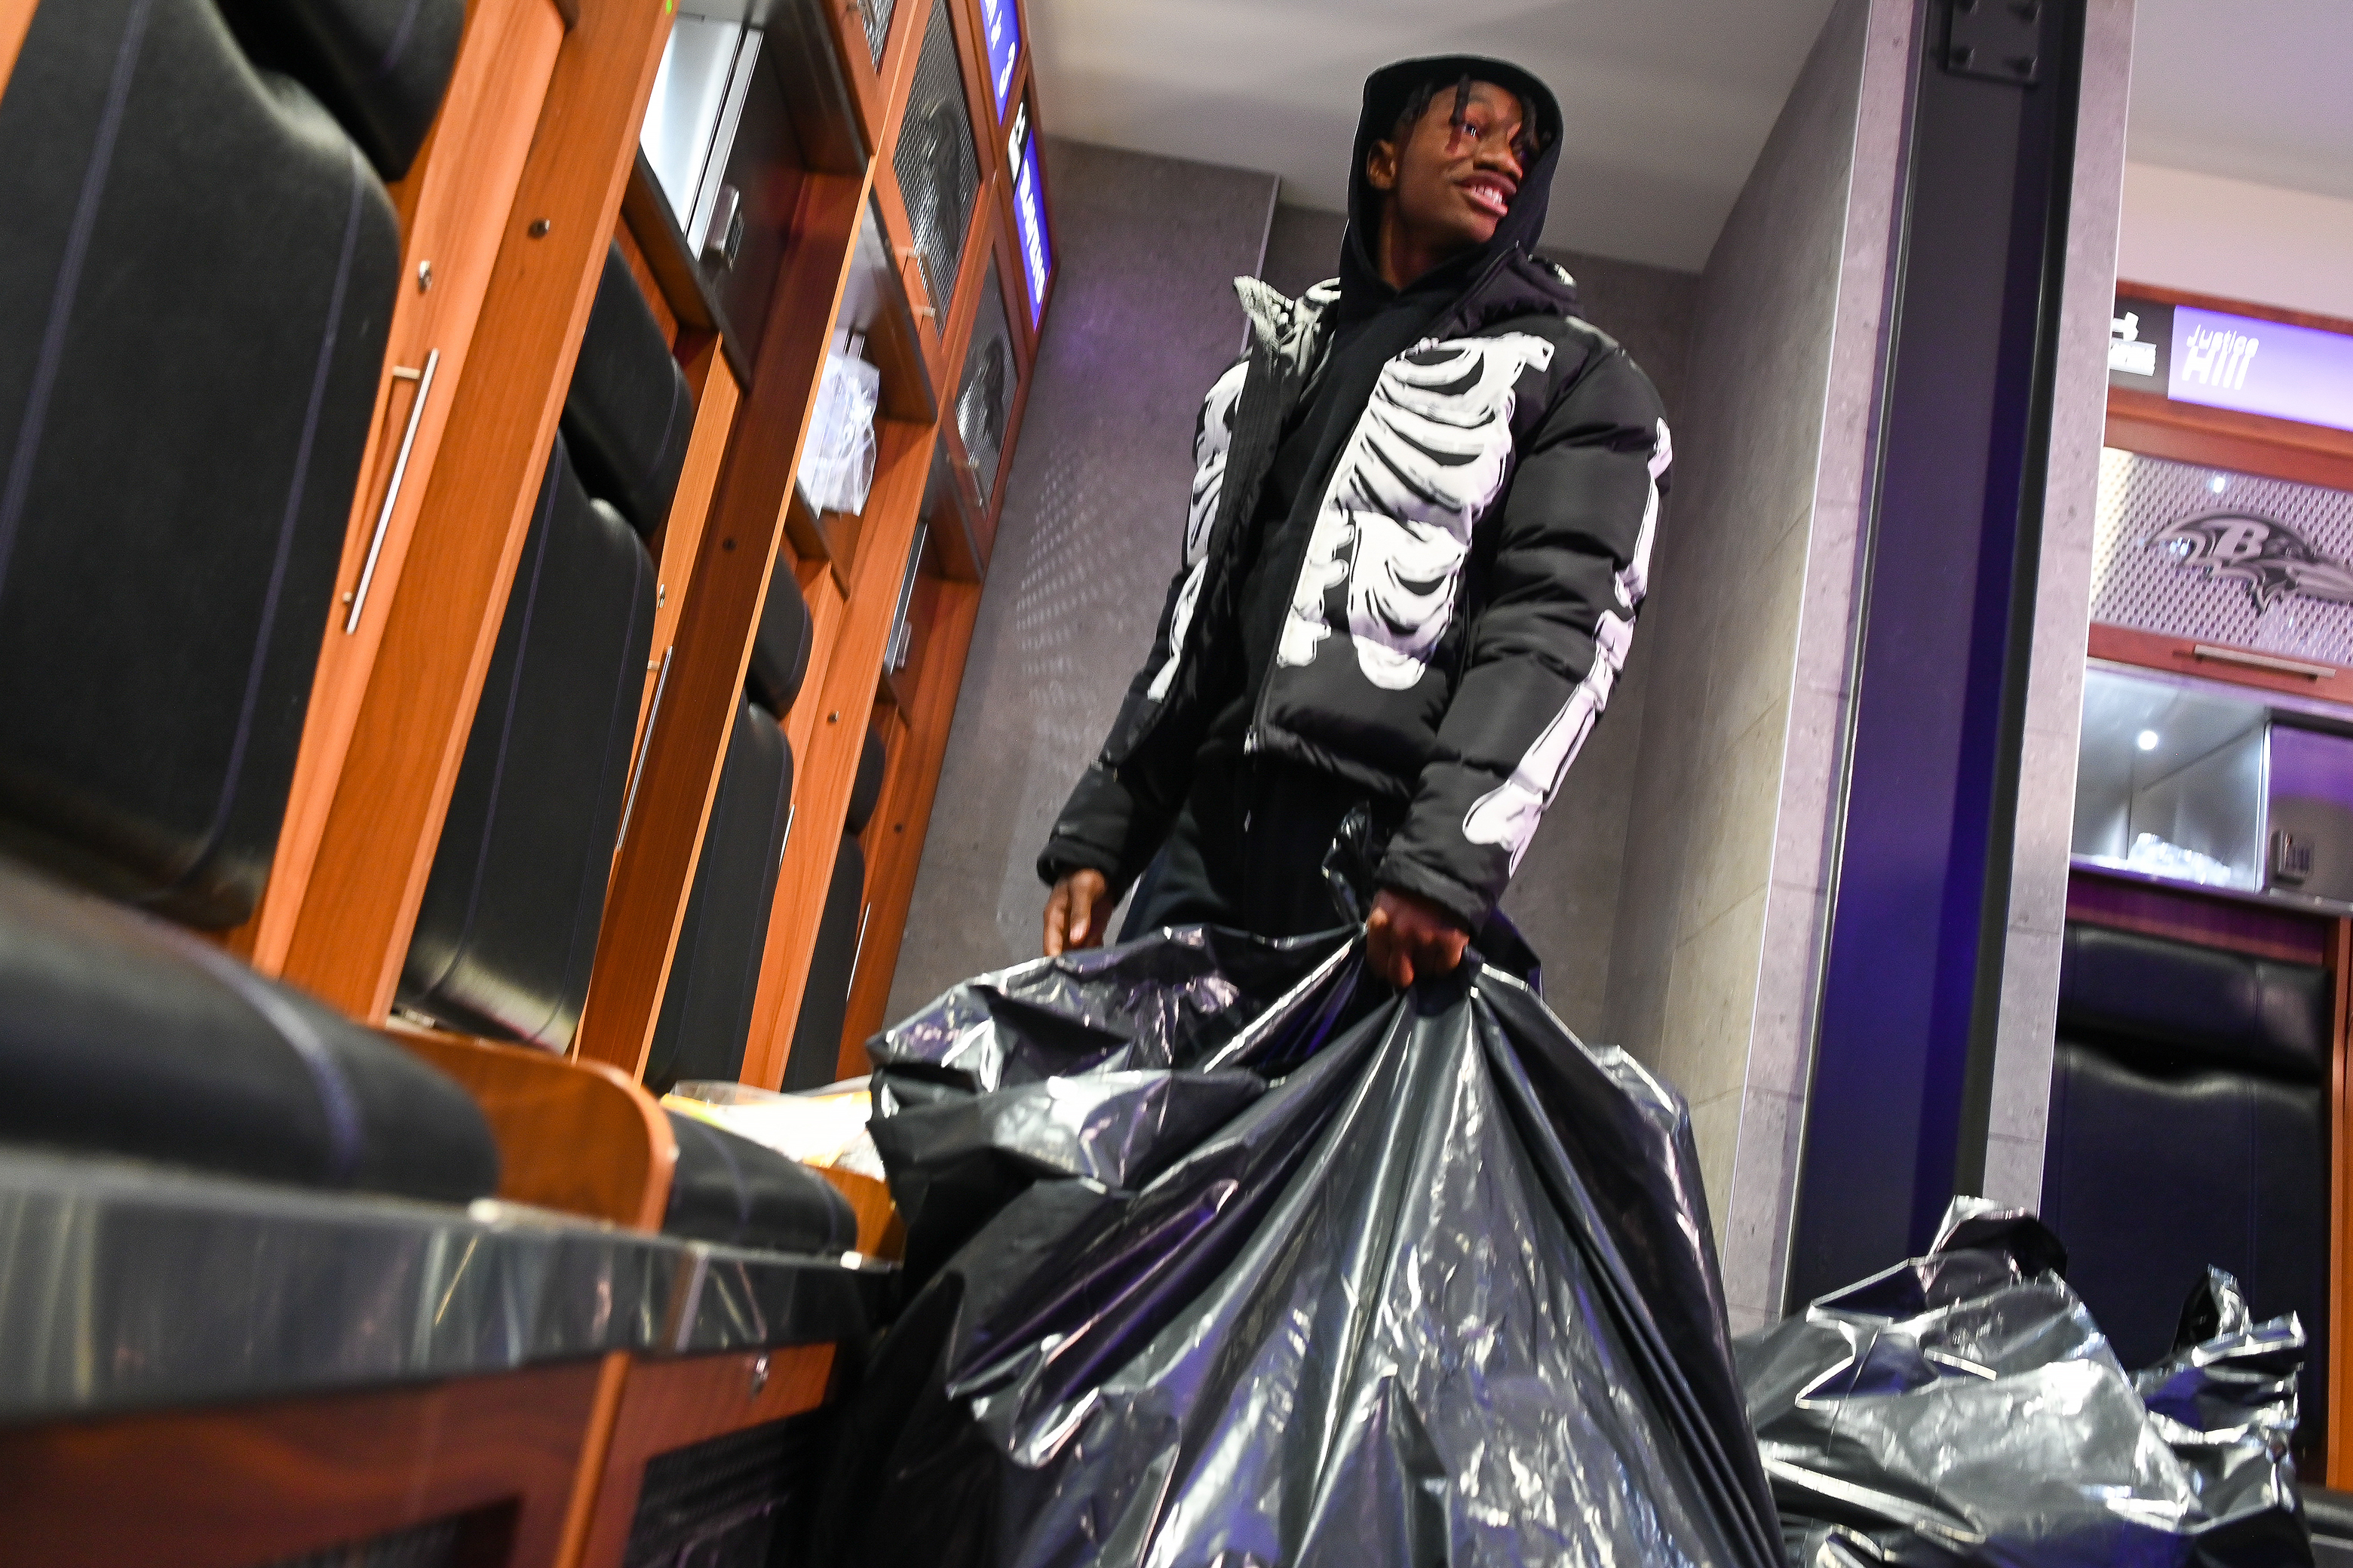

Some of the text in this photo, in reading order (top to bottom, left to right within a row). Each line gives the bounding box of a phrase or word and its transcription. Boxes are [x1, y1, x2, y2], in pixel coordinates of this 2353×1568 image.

[999, 41, 1016, 98] 3
[1019, 158, 1045, 305] RAVENS
[2186, 324, 2259, 358] Justice
[2182, 345, 2251, 391] Hill
